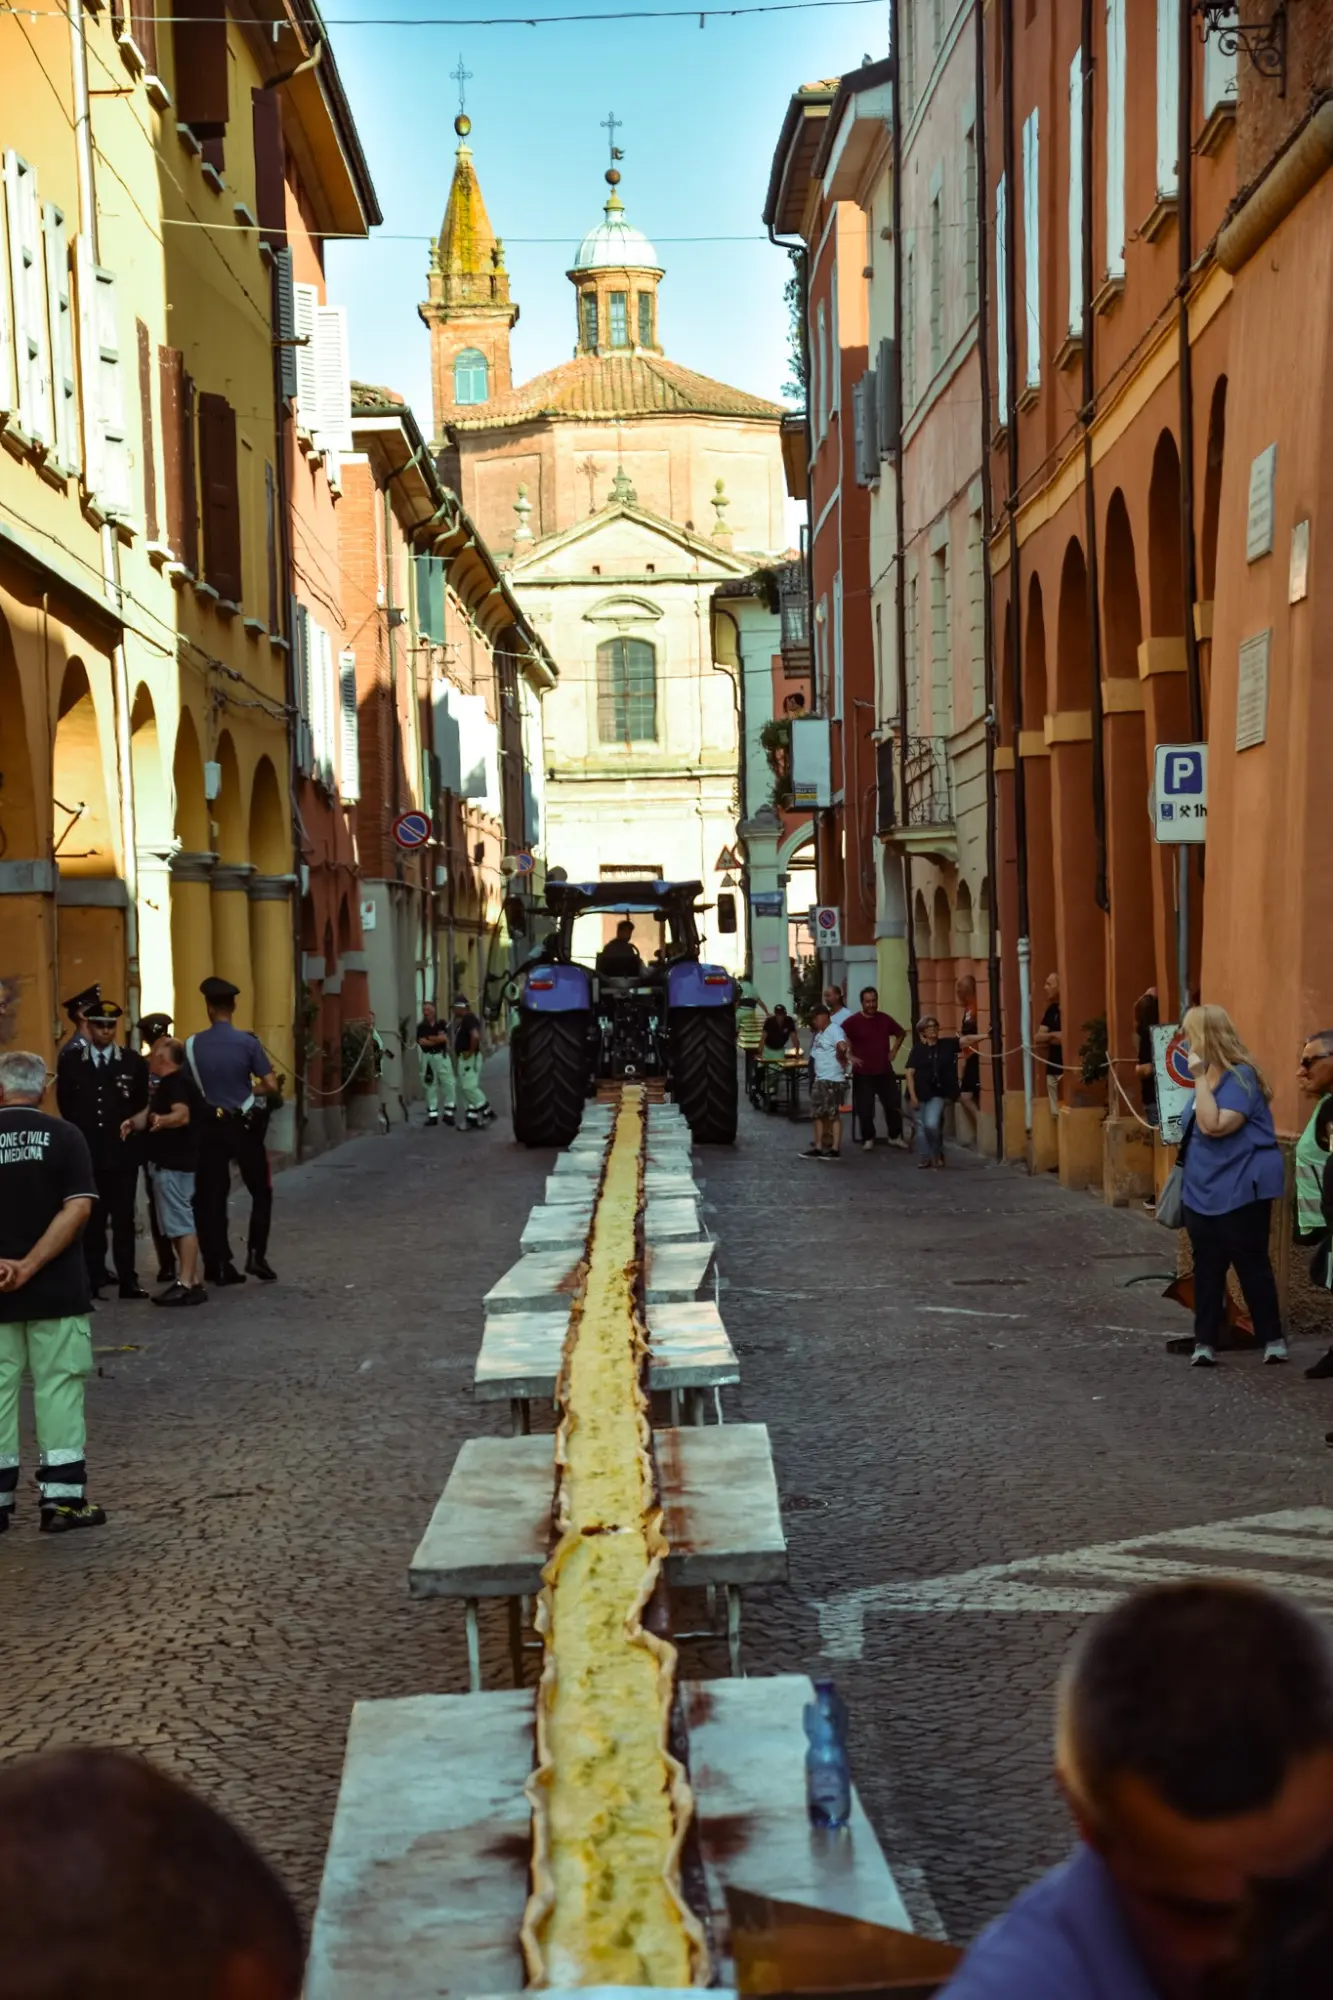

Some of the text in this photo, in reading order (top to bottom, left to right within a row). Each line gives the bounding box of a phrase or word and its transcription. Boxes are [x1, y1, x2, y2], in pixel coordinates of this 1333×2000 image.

[1173, 758, 1194, 789] P
[1194, 804, 1207, 817] 1h
[19, 1131, 50, 1146] CIVILE
